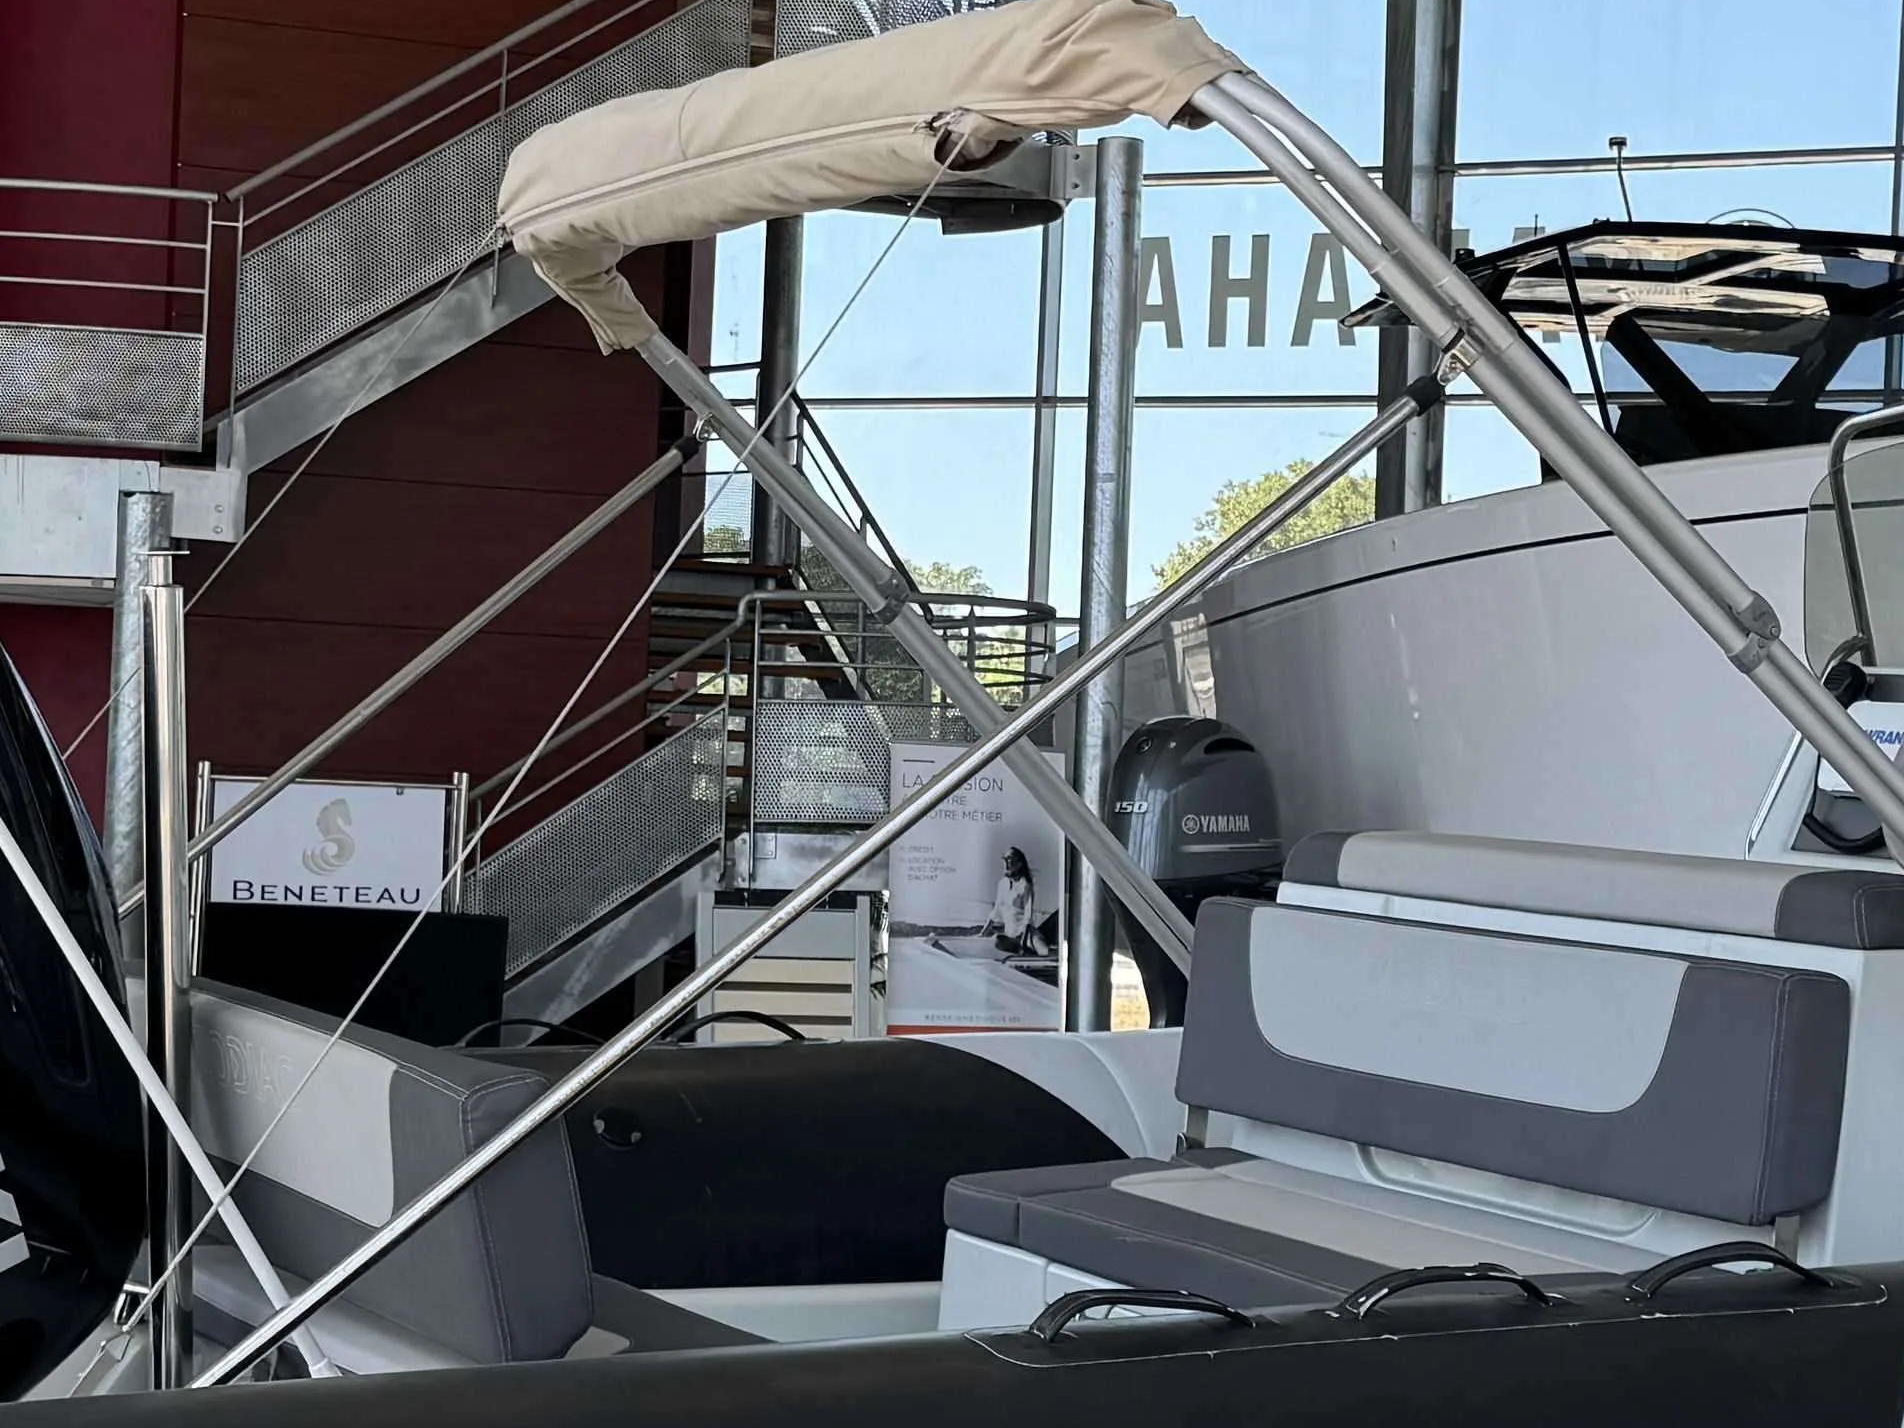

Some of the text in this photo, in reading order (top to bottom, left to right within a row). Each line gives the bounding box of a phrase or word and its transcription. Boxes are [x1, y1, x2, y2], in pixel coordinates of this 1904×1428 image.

[1114, 800, 1149, 815] 150
[1200, 814, 1251, 834] YAMAHA
[232, 879, 421, 905] BENETEAU
